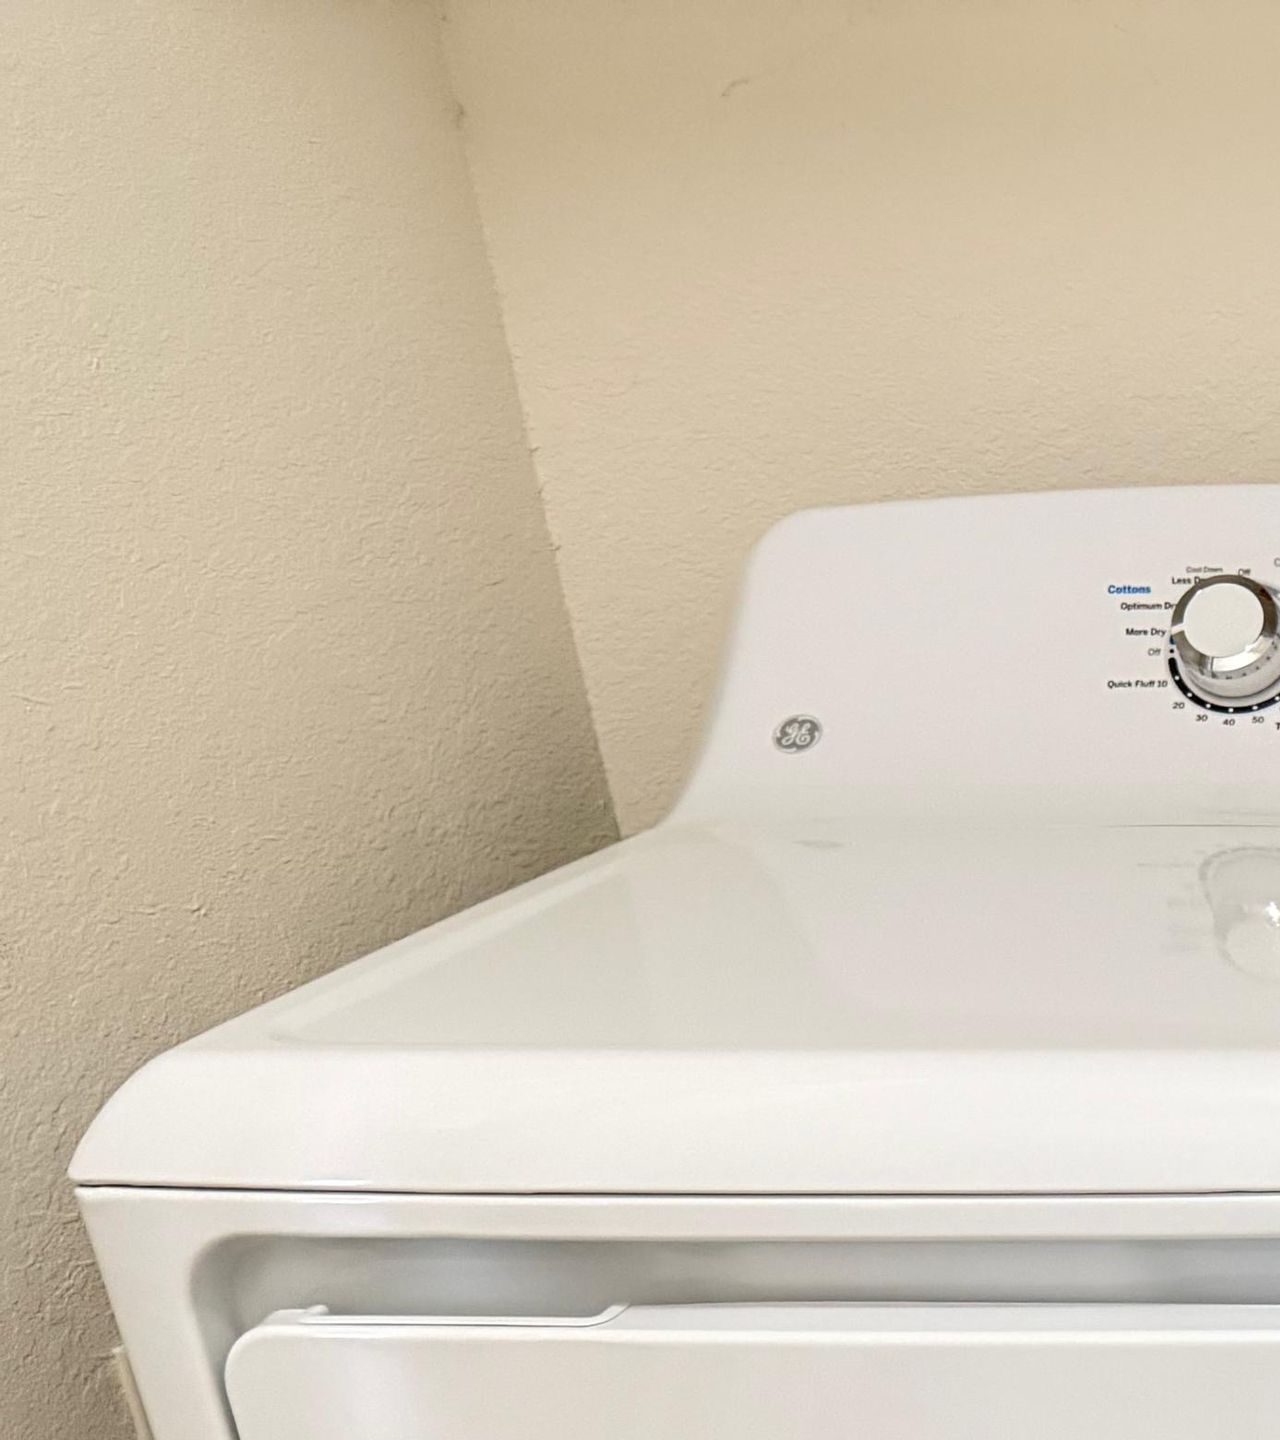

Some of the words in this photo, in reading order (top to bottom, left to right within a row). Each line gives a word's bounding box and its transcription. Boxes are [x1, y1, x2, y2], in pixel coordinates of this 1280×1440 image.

[1172, 576, 1191, 585] Less
[1107, 585, 1151, 594] Cottons
[1121, 602, 1162, 612] Optimum
[1126, 628, 1148, 636] More
[1151, 628, 1166, 638] Dry
[1107, 680, 1133, 689] Quick
[1135, 680, 1155, 688] Fluff
[1172, 702, 1185, 710] 20
[1195, 714, 1208, 722] 30
[1222, 718, 1236, 726] 40
[1252, 716, 1265, 724] 50
